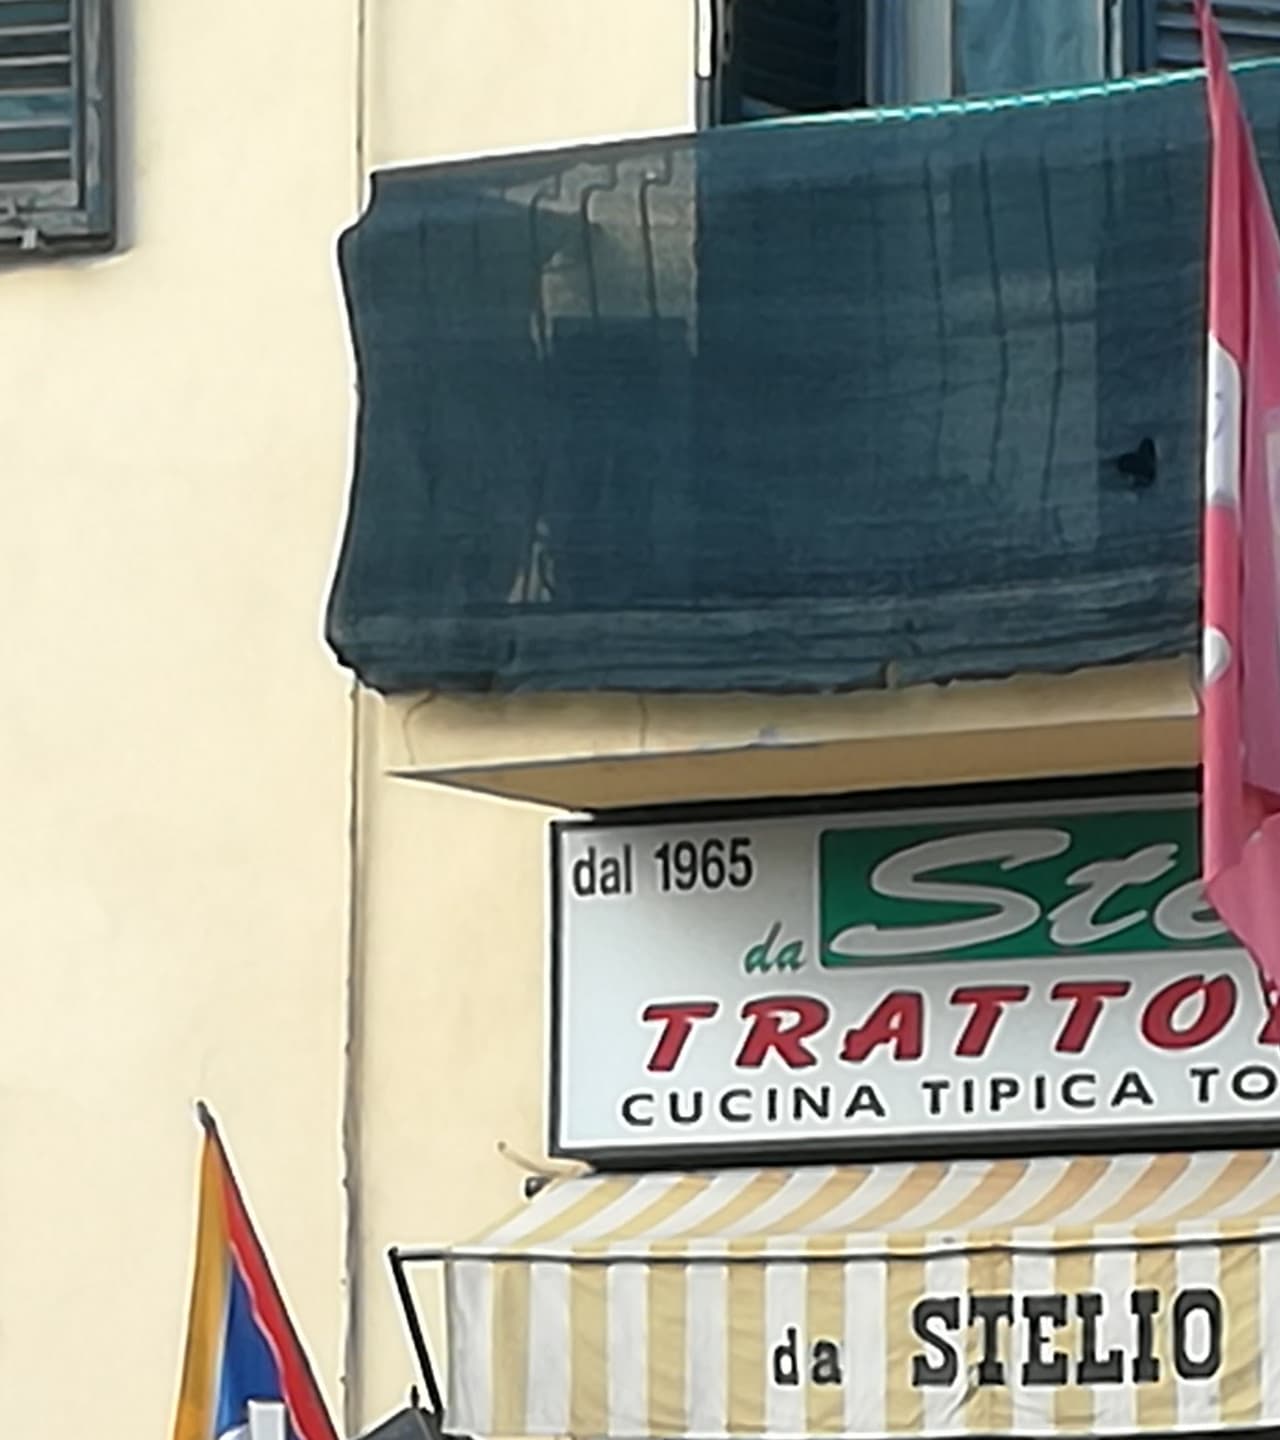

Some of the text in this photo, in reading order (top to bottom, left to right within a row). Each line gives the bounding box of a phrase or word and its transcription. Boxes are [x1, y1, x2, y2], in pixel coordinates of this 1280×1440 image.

[573, 836, 752, 896] dal 1965
[744, 921, 805, 974] da
[621, 1083, 886, 1127] CUCINA
[921, 1071, 1154, 1115] TIPICA
[773, 1288, 1221, 1386] da STELIO
